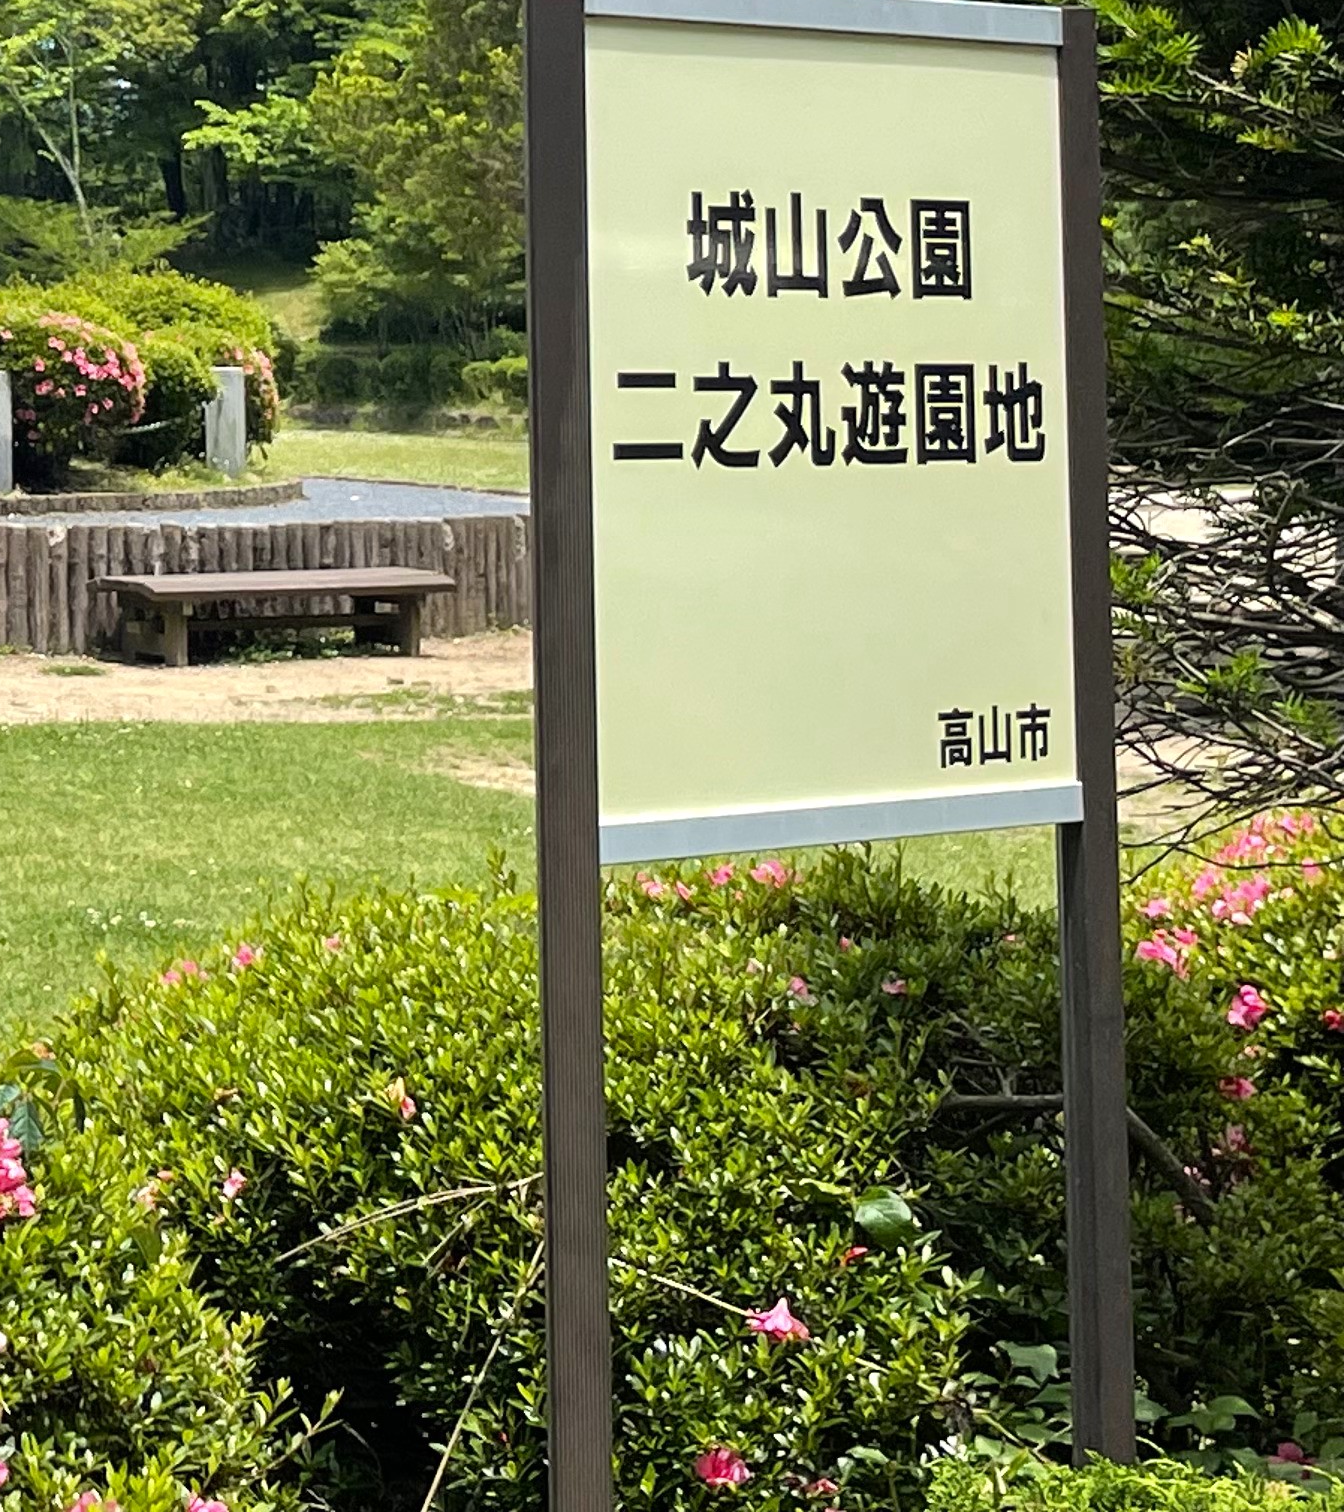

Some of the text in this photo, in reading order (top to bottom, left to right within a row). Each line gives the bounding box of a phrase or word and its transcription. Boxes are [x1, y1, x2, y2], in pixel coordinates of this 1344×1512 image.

[685, 189, 973, 300] 城山公園
[612, 360, 1046, 469] 二之丸遊園地
[937, 703, 1051, 769] 高山市
